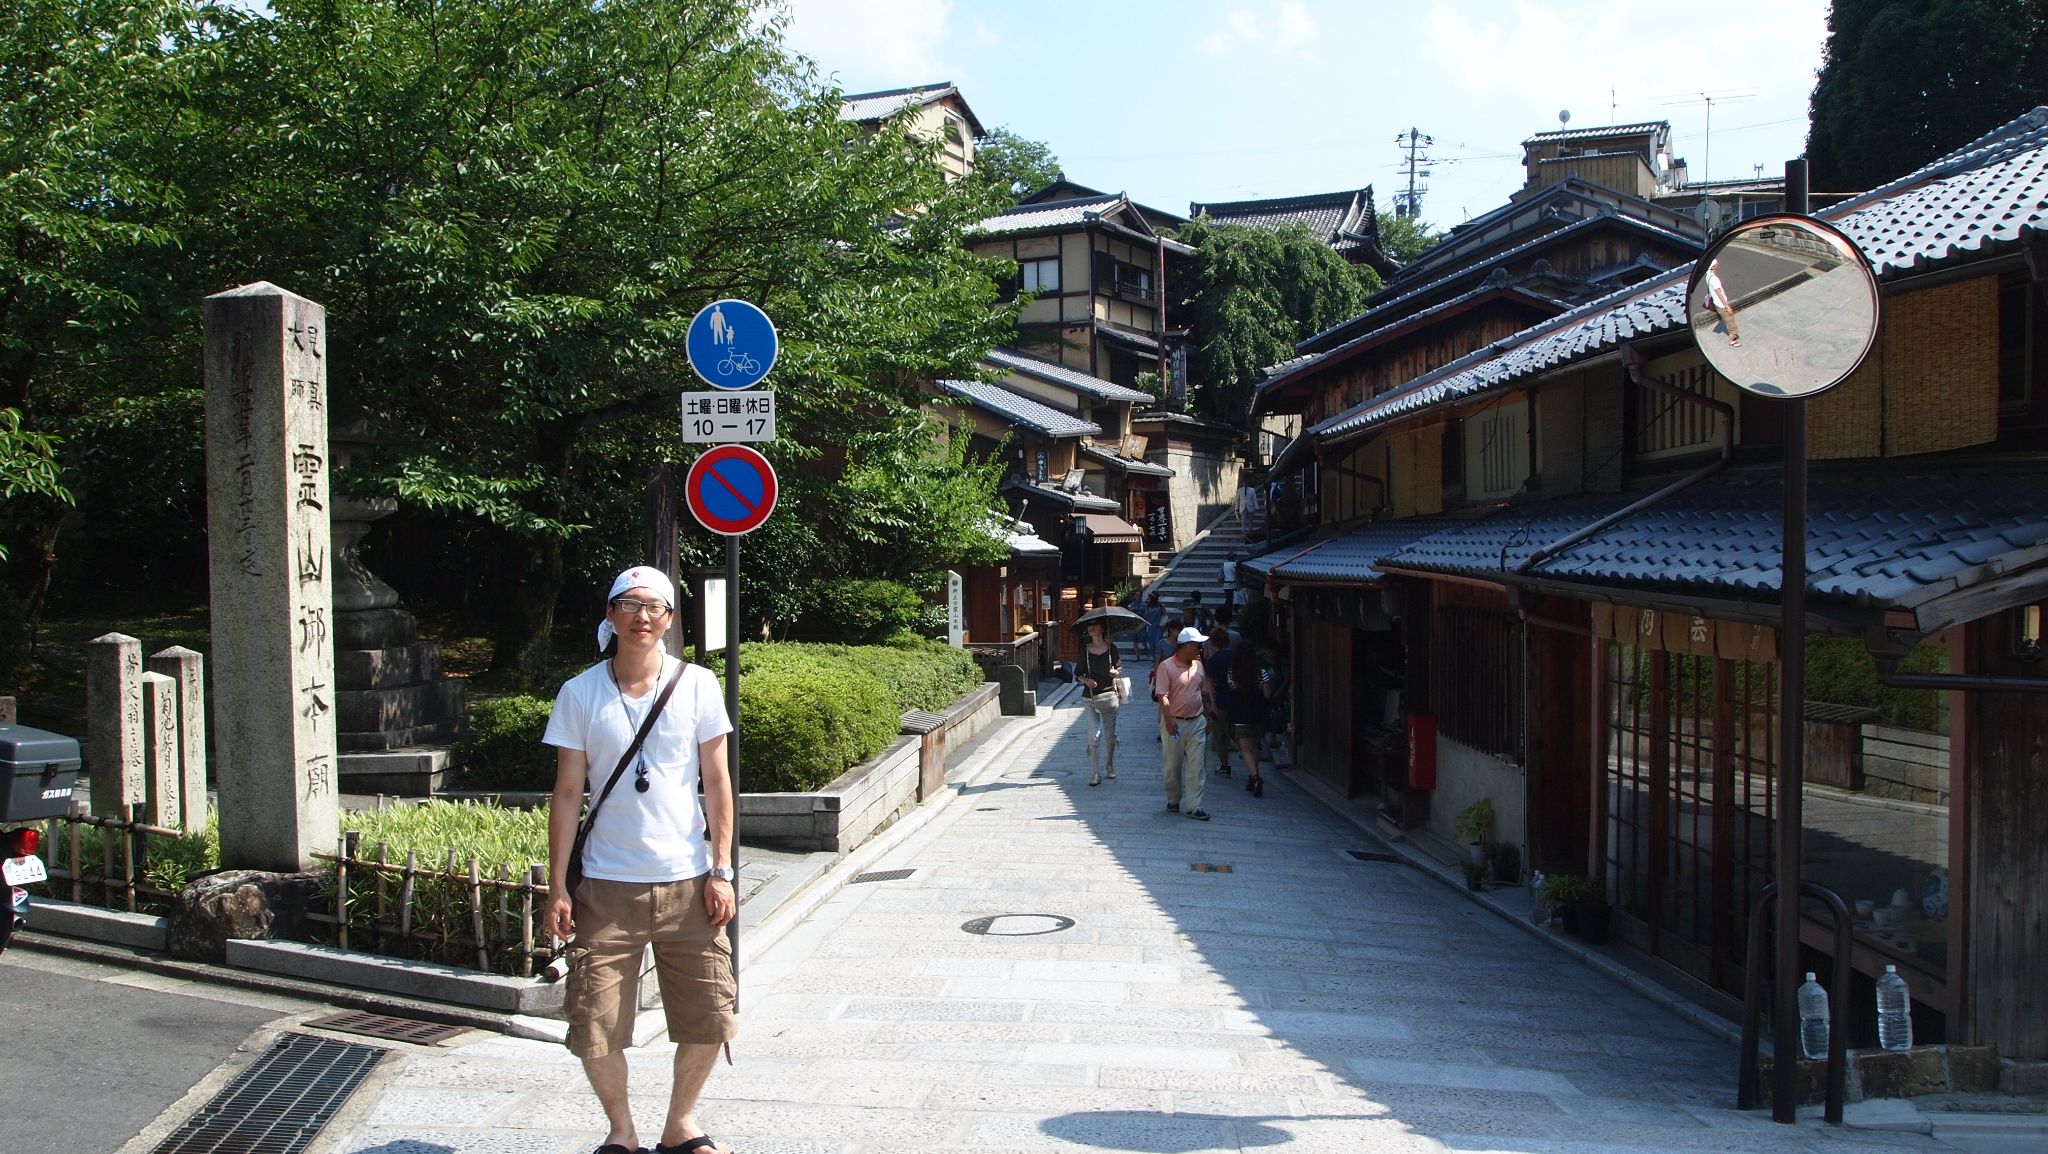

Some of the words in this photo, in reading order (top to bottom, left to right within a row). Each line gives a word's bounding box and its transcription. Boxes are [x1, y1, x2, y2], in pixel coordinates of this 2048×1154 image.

[686, 397, 771, 417] 土曜・日曜・休日
